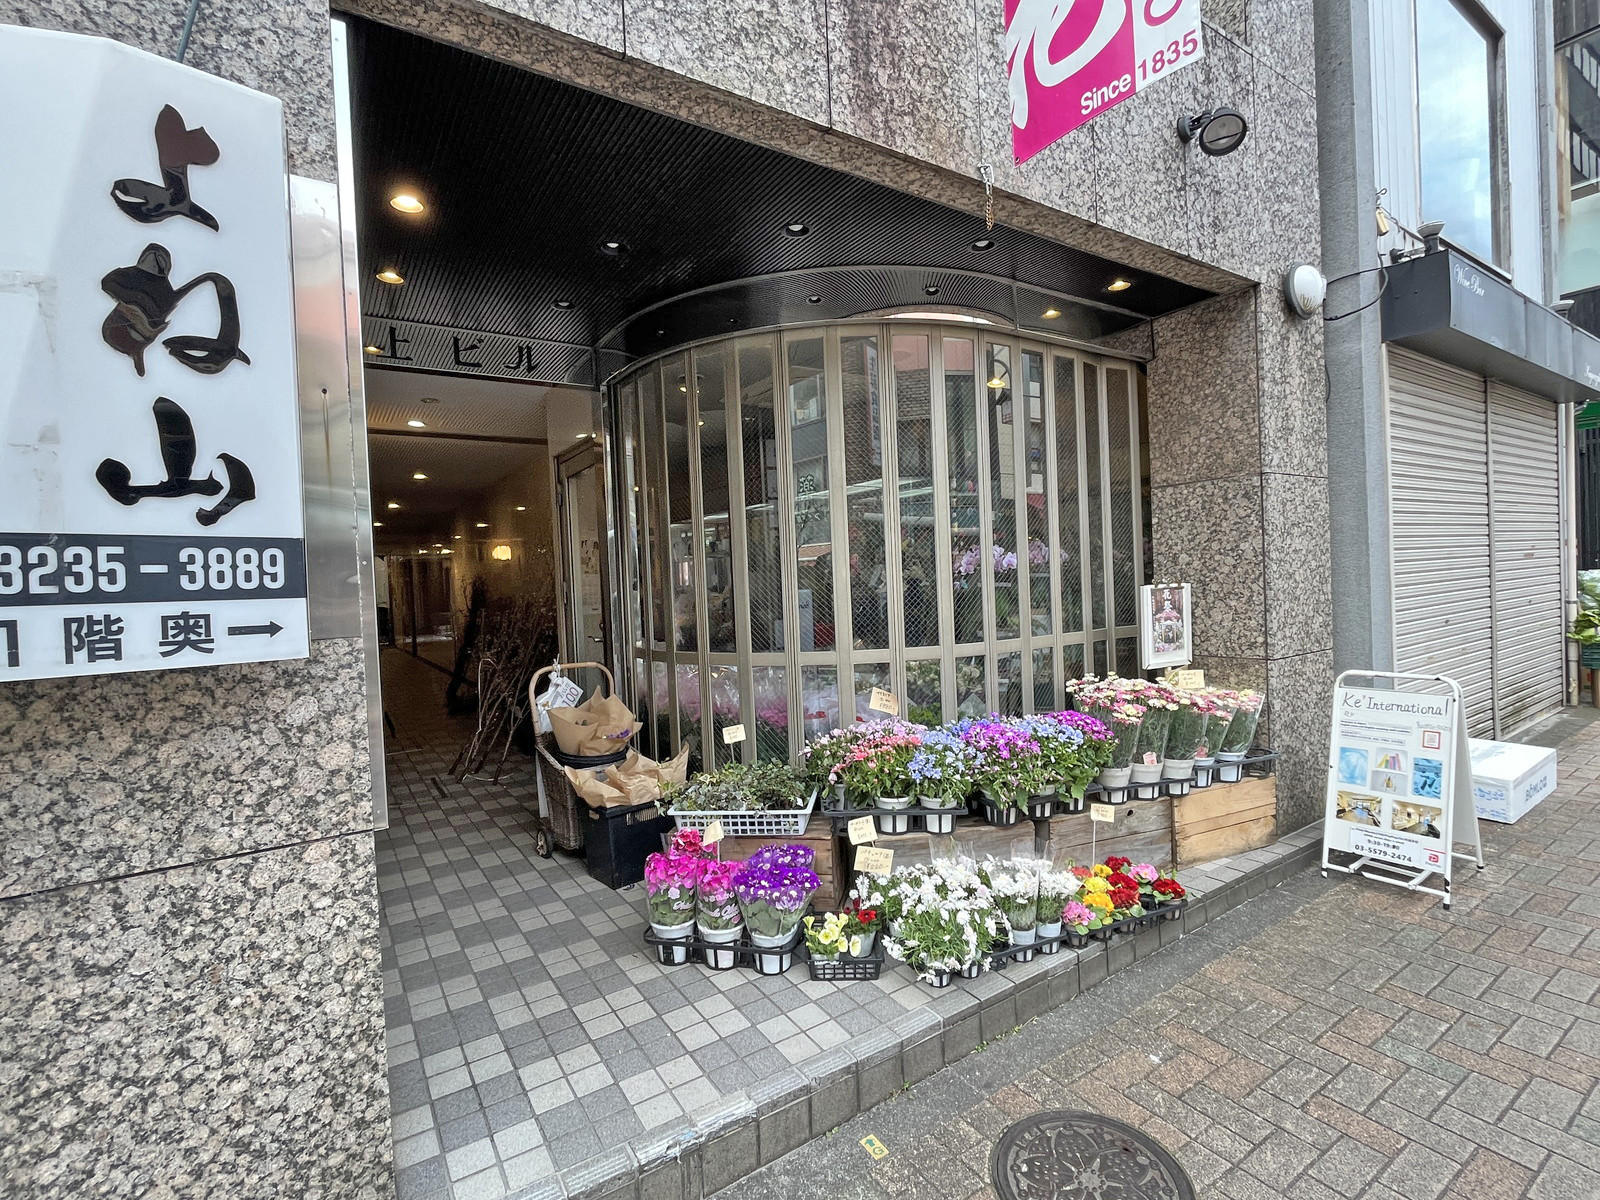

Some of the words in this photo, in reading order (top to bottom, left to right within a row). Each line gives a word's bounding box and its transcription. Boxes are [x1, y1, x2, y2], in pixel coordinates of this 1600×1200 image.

[1080, 73, 1132, 116] Since
[1137, 28, 1199, 82] 1835
[1366, 696, 1450, 717] International
[1354, 844, 1413, 864] 03-5579-2474
